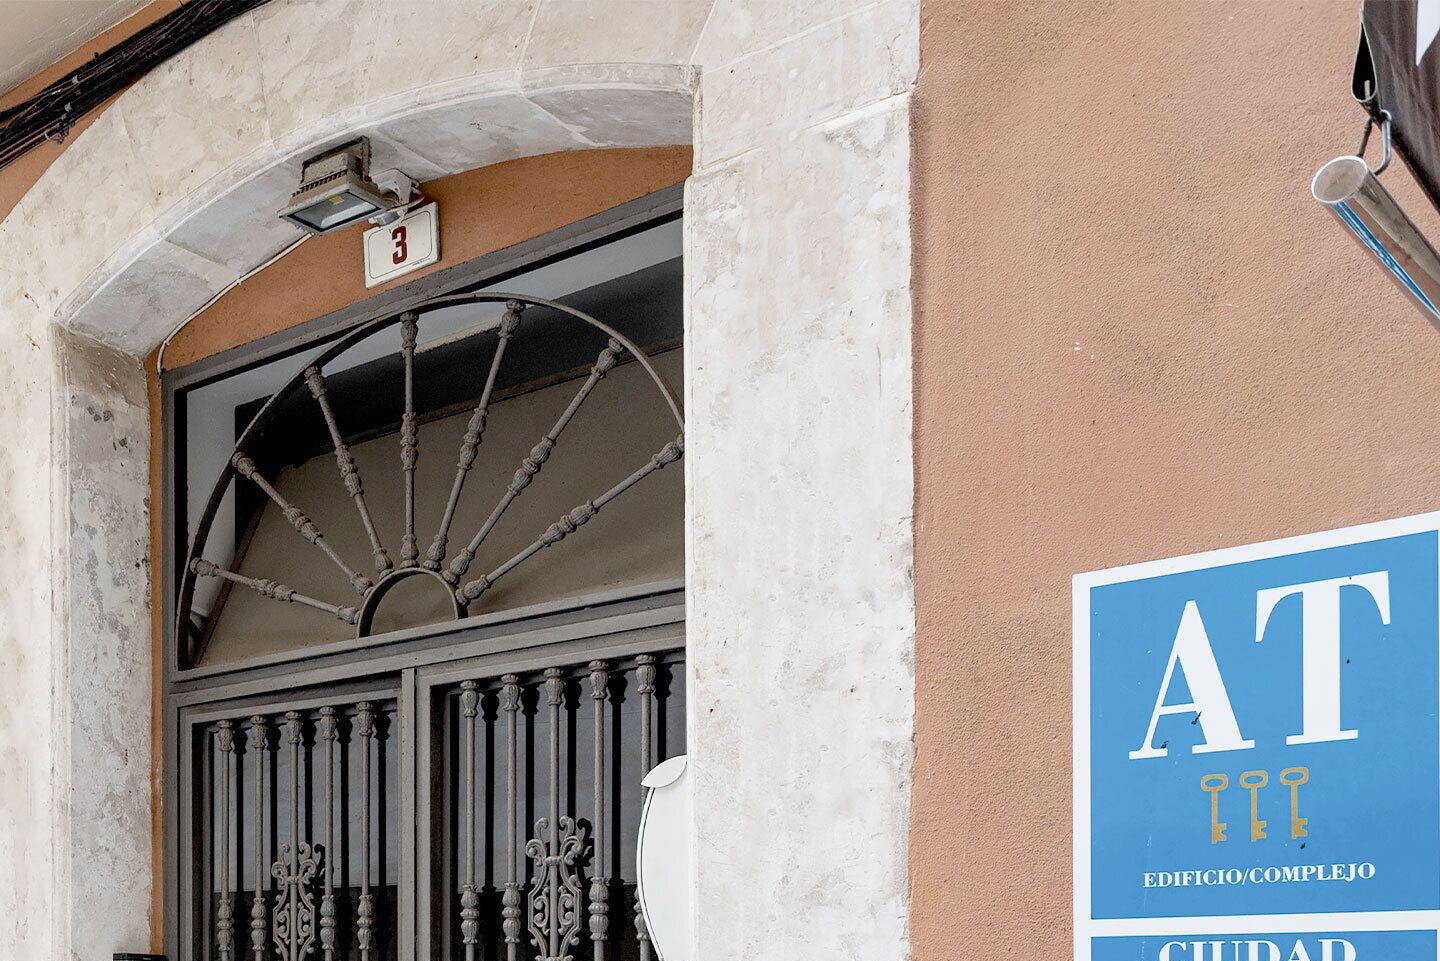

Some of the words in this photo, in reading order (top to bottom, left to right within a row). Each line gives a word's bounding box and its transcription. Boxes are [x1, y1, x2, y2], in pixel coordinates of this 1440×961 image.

[391, 225, 408, 265] 3
[1128, 570, 1391, 760] AT
[1143, 861, 1376, 888] EDIFICIO/COMPLEJO
